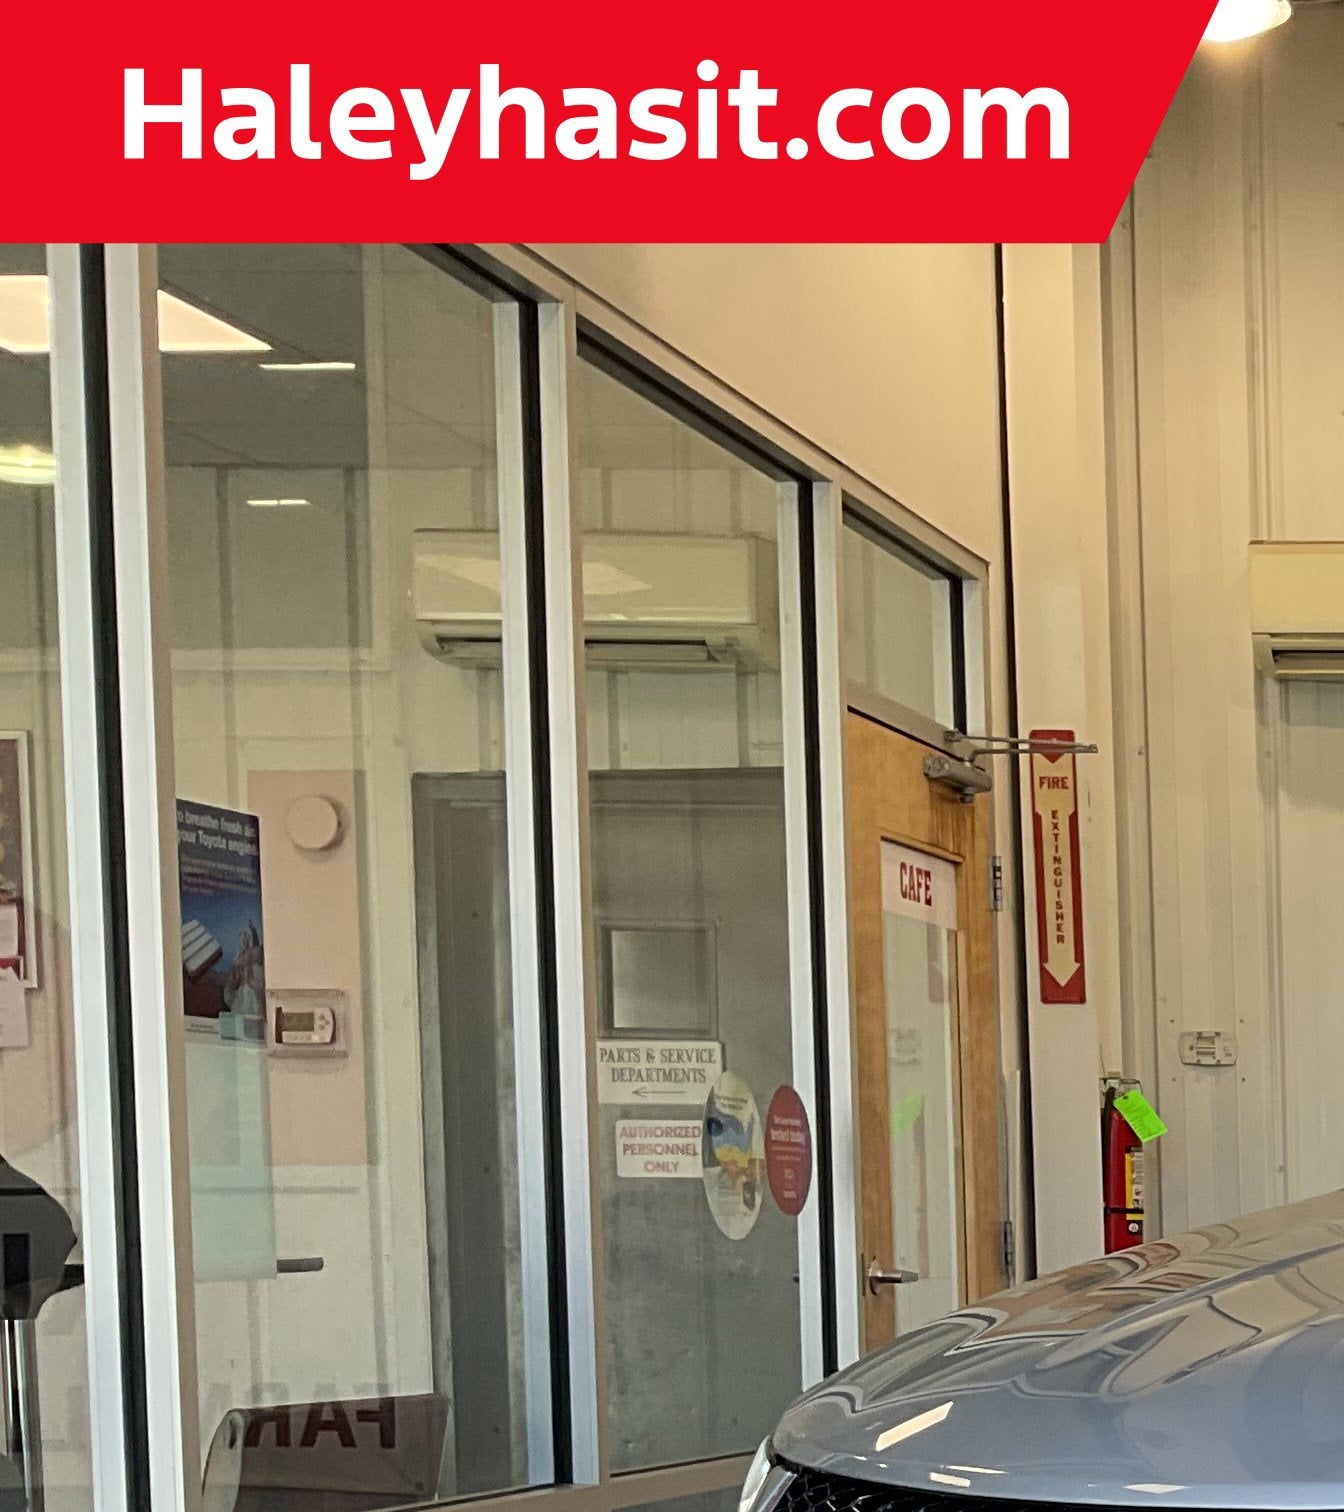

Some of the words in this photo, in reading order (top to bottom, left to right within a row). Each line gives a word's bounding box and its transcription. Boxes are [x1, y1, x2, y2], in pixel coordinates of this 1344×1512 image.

[1039, 776, 1069, 790] FIRE
[900, 861, 932, 907] CAFE
[1050, 809, 1066, 944] EXTINGUISHER
[600, 1047, 641, 1063] PARTS
[646, 1048, 656, 1063] &
[660, 1048, 717, 1064] SERVICE
[611, 1067, 706, 1084] DEPARTMENTS
[619, 1125, 700, 1139] AUTHORIZED
[623, 1142, 699, 1156] PERSONNEL
[643, 1160, 679, 1173] ONLY
